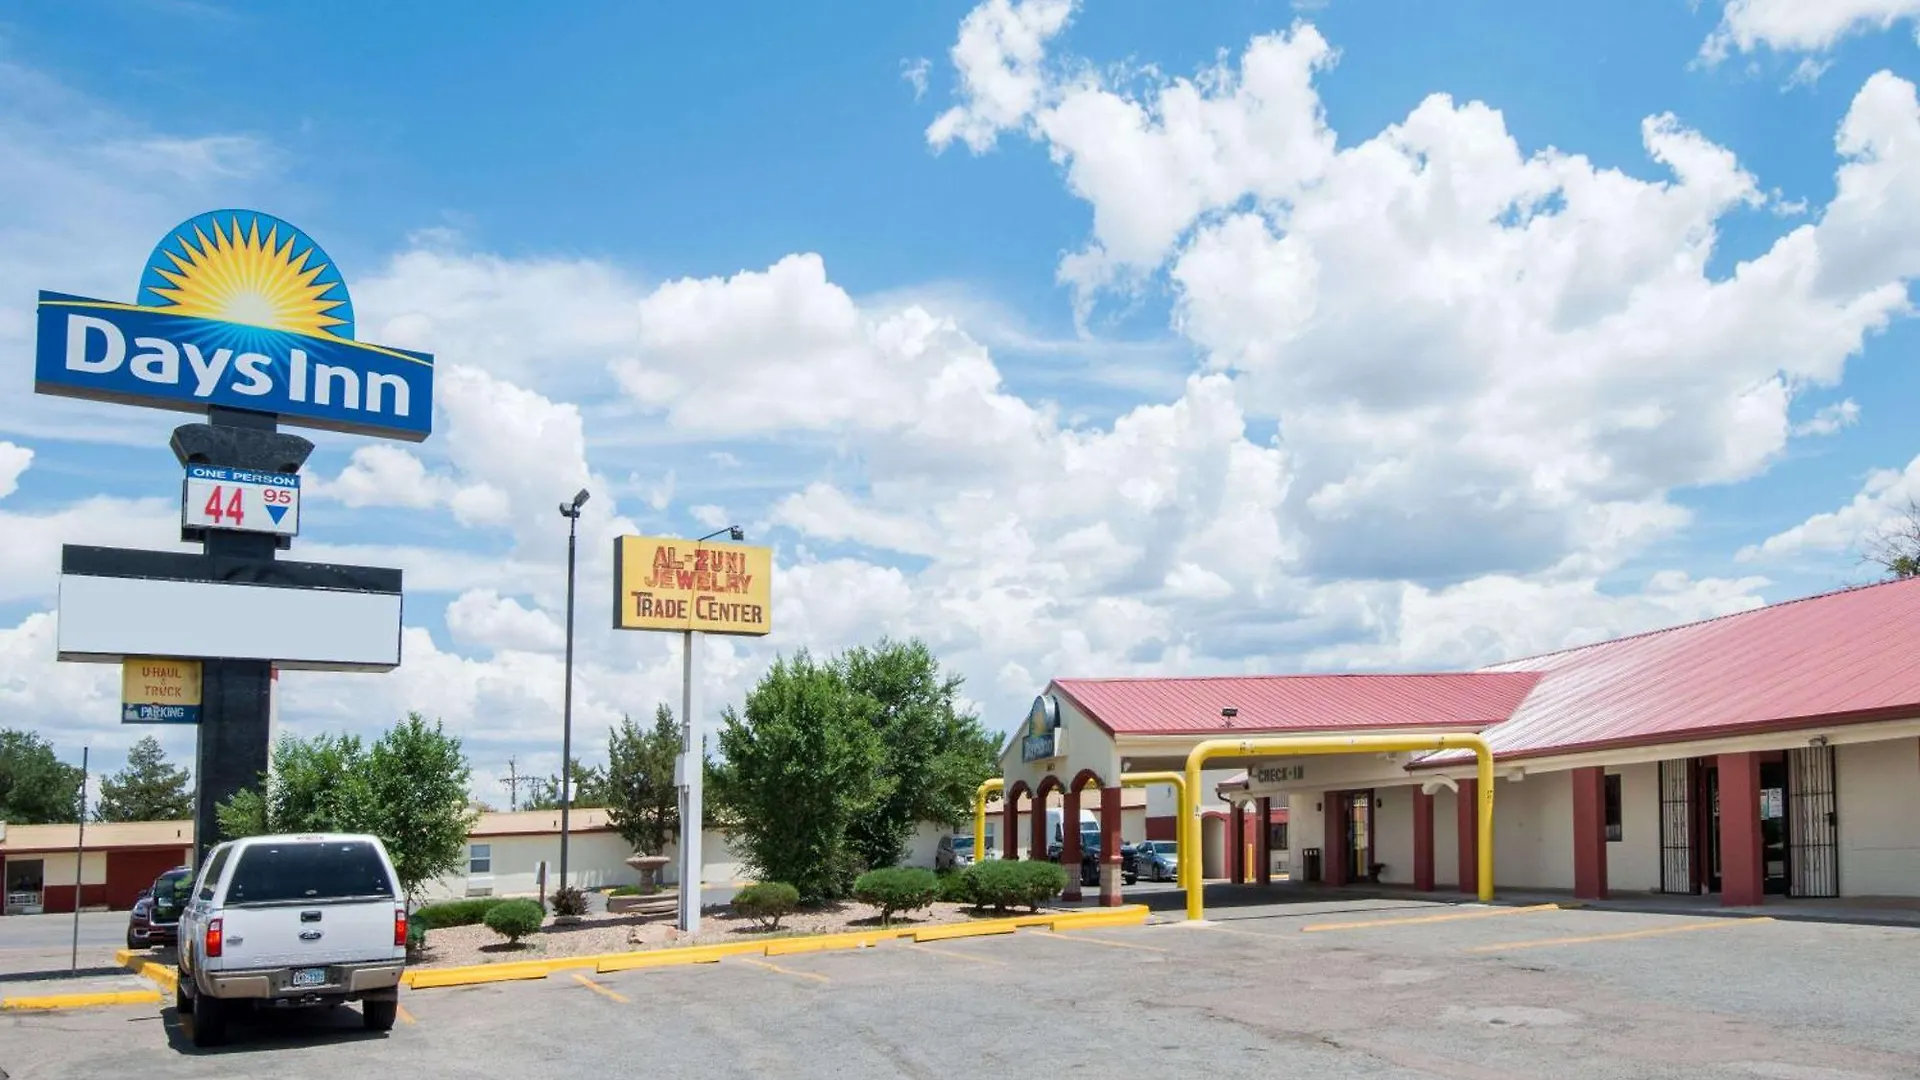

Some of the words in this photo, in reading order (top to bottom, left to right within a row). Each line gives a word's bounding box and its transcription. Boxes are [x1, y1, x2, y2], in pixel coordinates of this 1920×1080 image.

[66, 313, 273, 397] Days
[289, 347, 410, 417] Inn
[193, 468, 227, 479] ONE
[233, 473, 295, 485] PERSON
[204, 485, 244, 526] 44
[263, 488, 291, 504] 95
[644, 570, 752, 594] JEWELRY
[631, 591, 688, 619] TRADE
[695, 595, 762, 624] CENTER
[144, 686, 182, 697] TRUCK
[140, 706, 184, 718] PARKING
